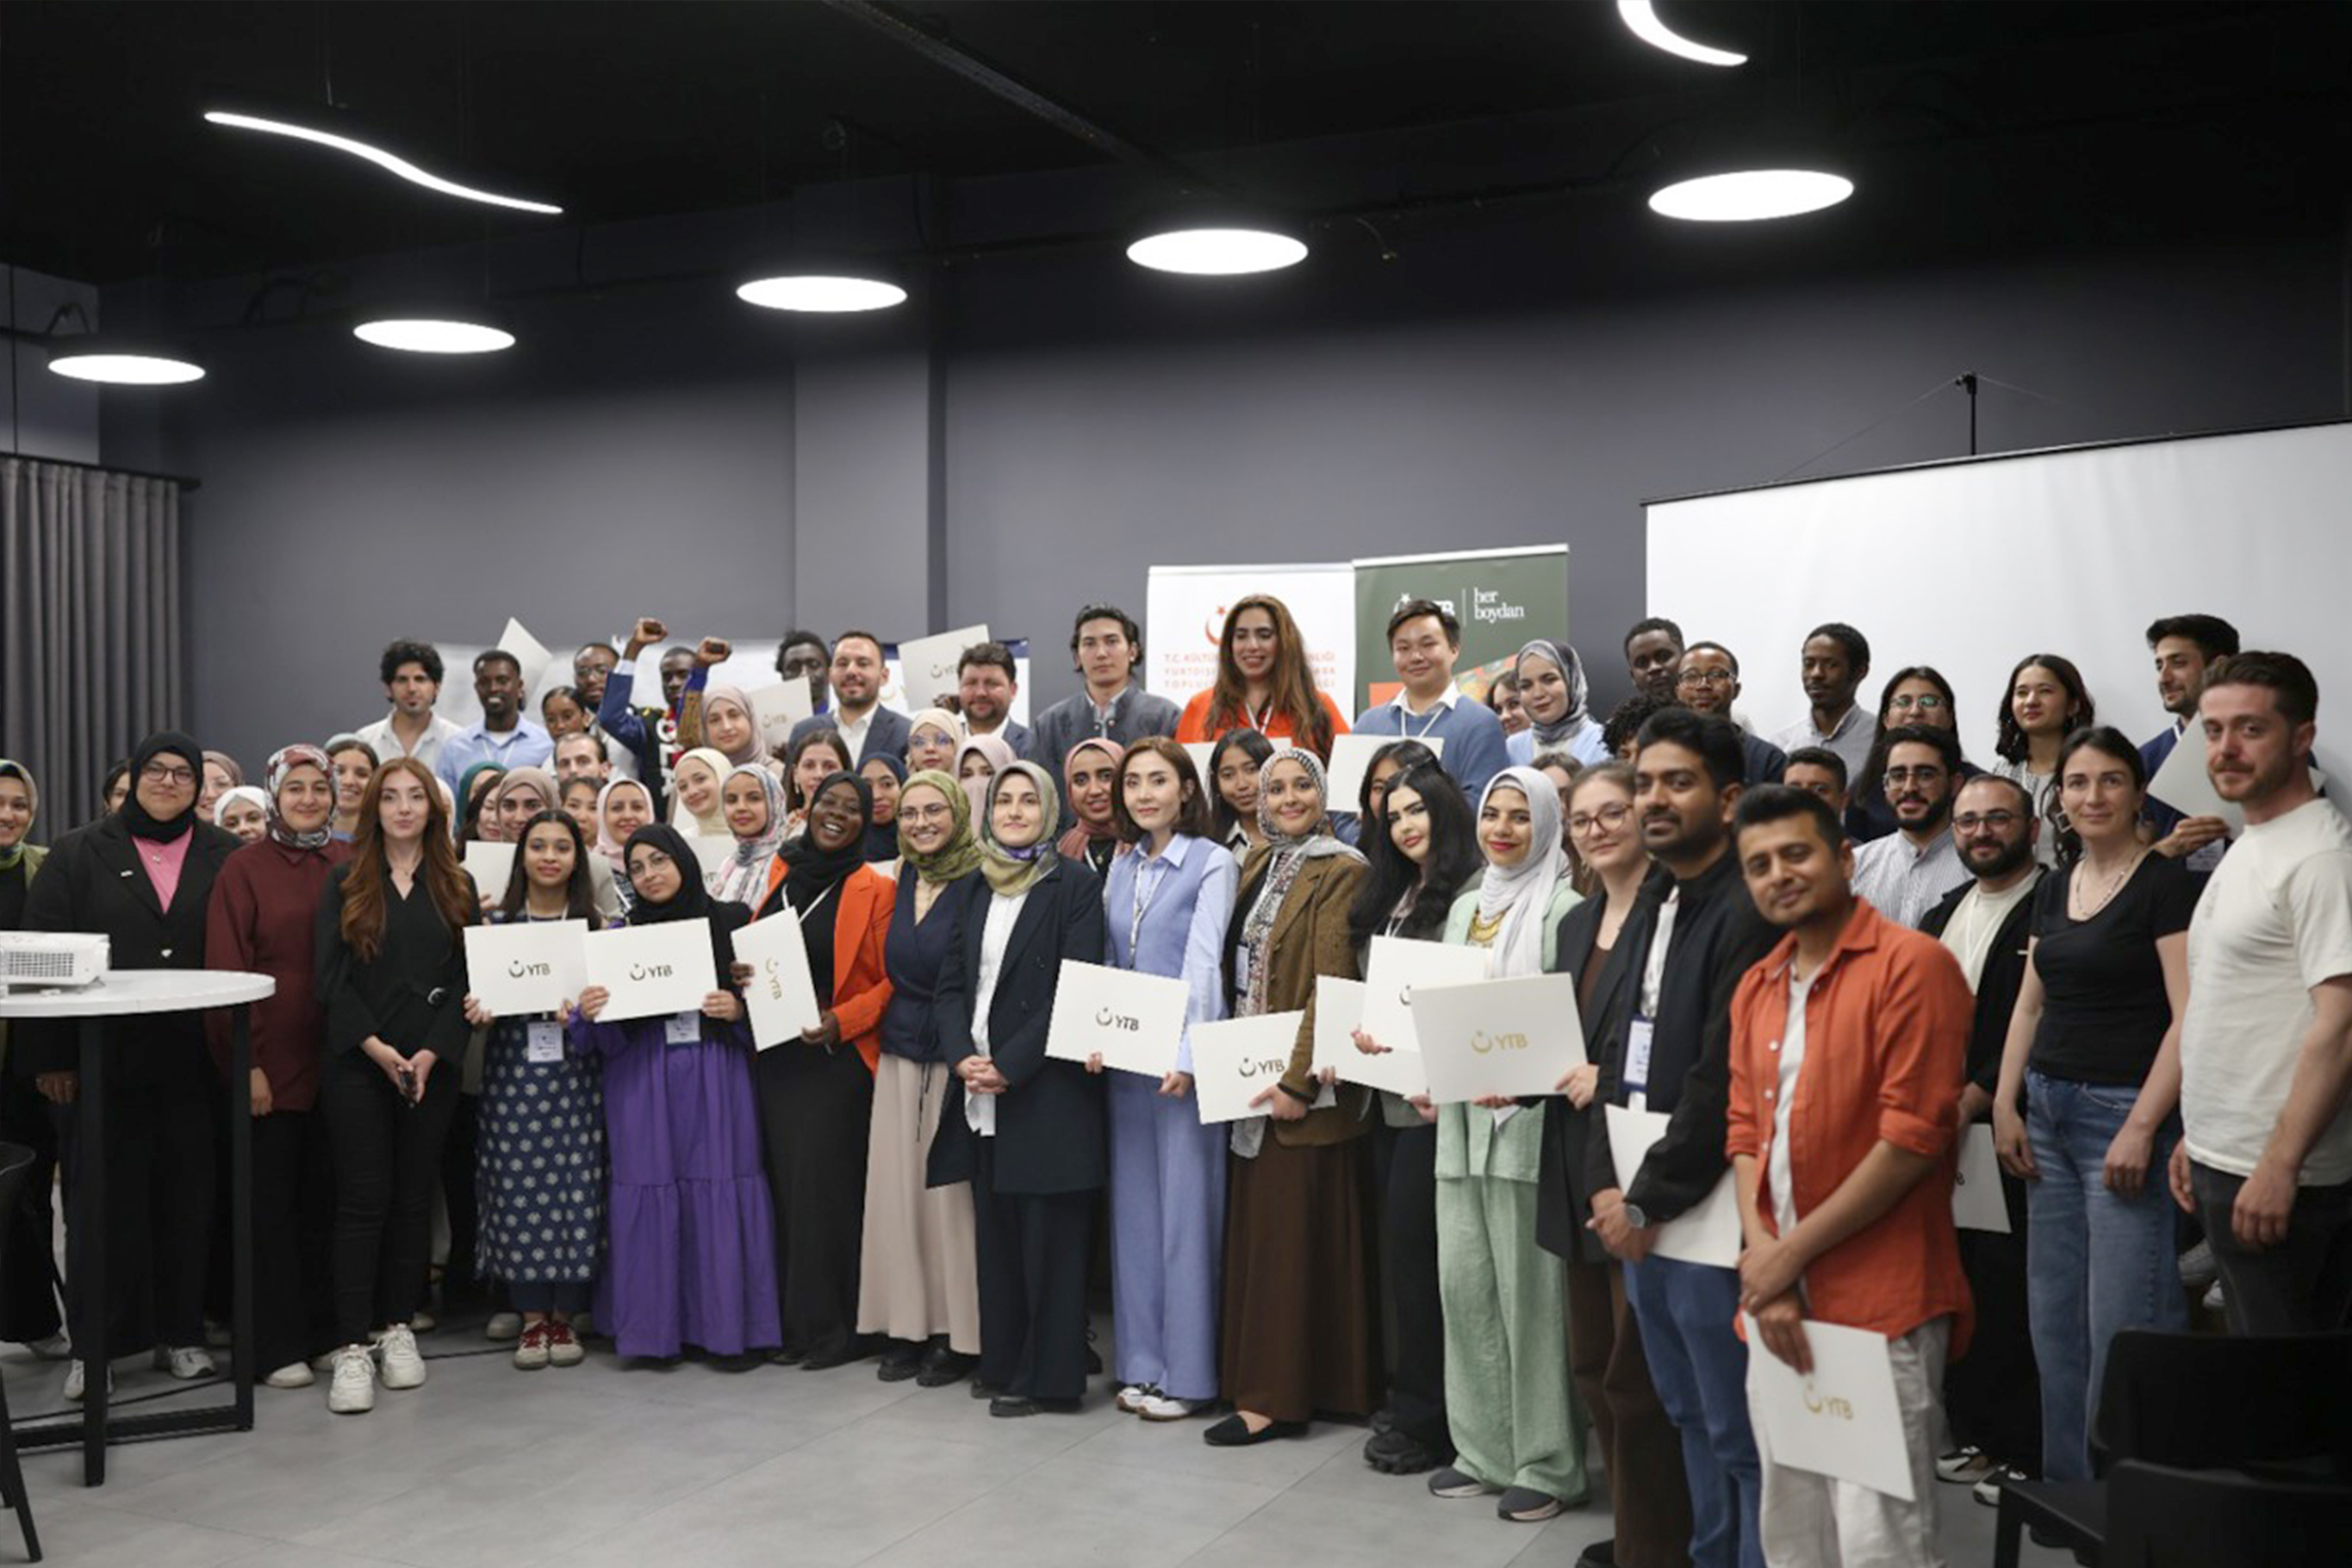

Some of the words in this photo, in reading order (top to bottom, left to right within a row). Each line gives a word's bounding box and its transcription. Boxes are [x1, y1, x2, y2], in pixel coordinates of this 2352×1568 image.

[1474, 588, 1498, 603] her
[1474, 602, 1524, 624] boydan
[526, 963, 551, 976] YTB
[648, 965, 673, 977] YTB
[769, 974, 782, 1000] YTB
[1115, 1015, 1139, 1031] YTB
[1495, 1032, 1528, 1049] YTB
[1259, 1059, 1285, 1074] YTB
[1824, 1396, 1853, 1420] YTB
